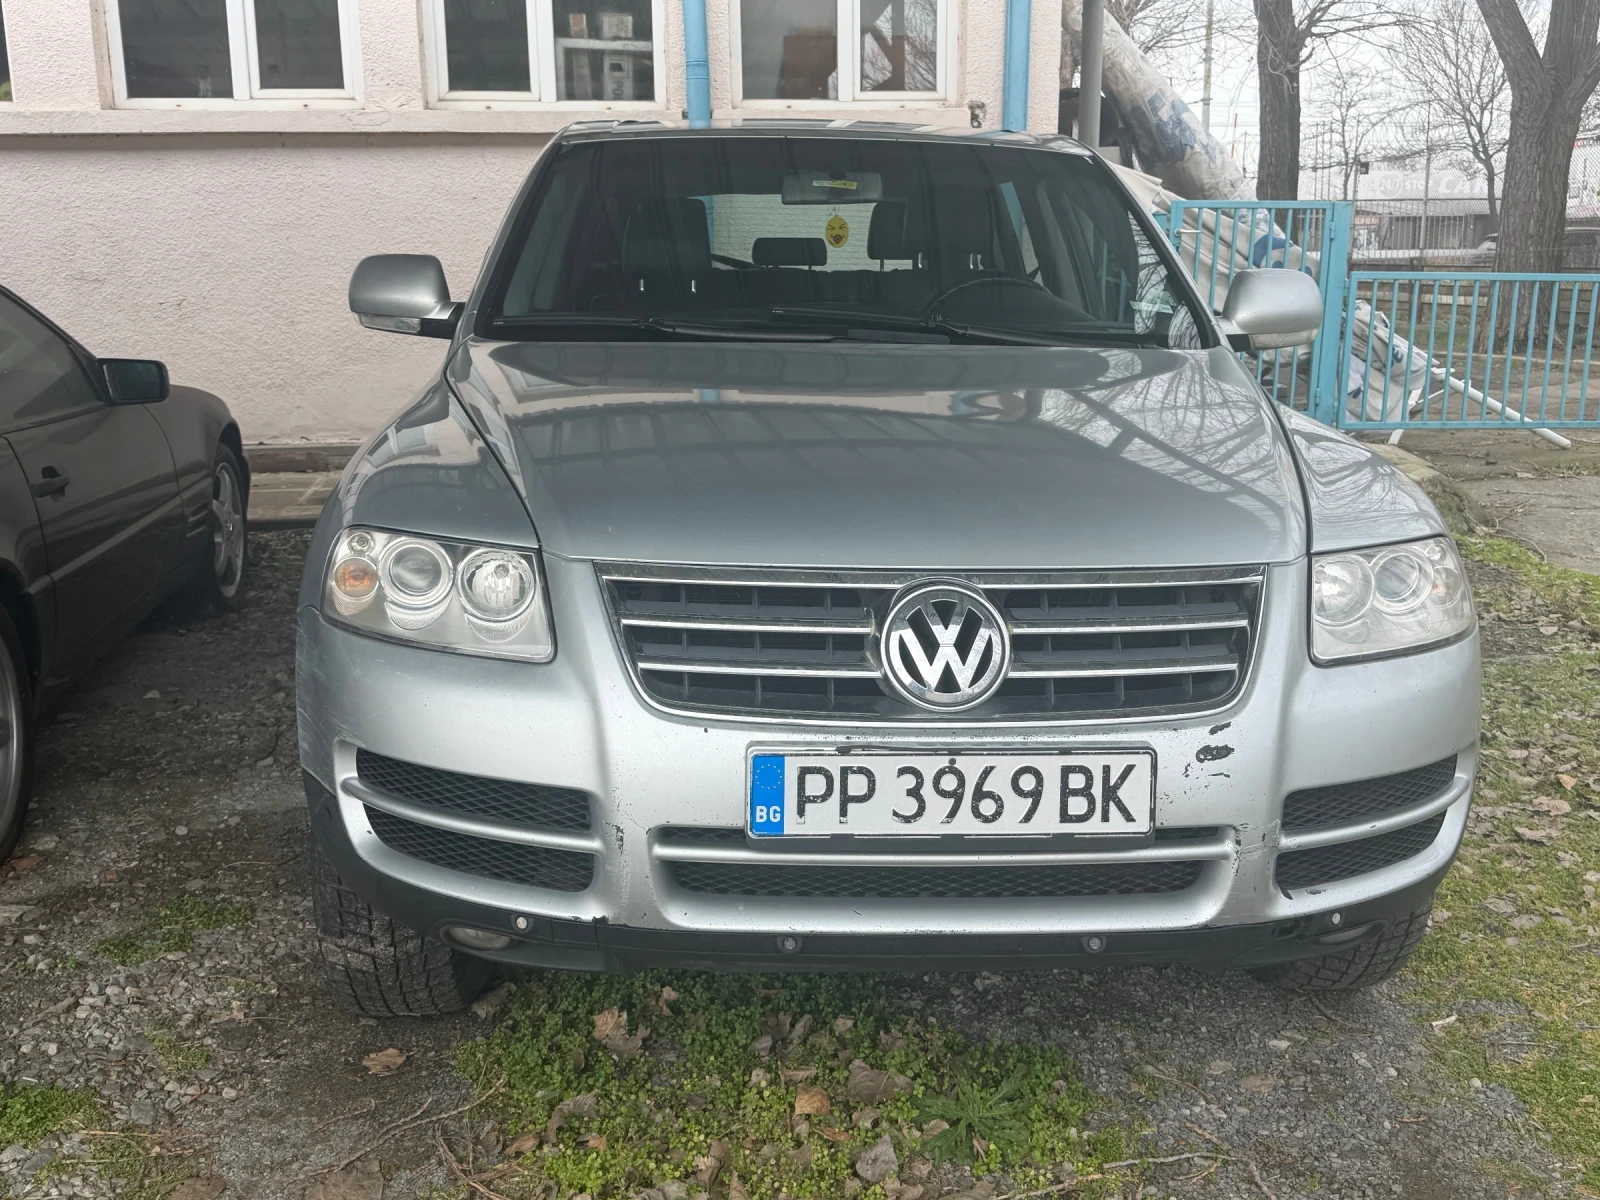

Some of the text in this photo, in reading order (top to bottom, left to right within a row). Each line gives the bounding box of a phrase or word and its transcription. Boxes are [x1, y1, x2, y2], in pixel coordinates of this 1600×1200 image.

[796, 764, 1137, 824] PP 3969 BK
[755, 805, 781, 822] BG
